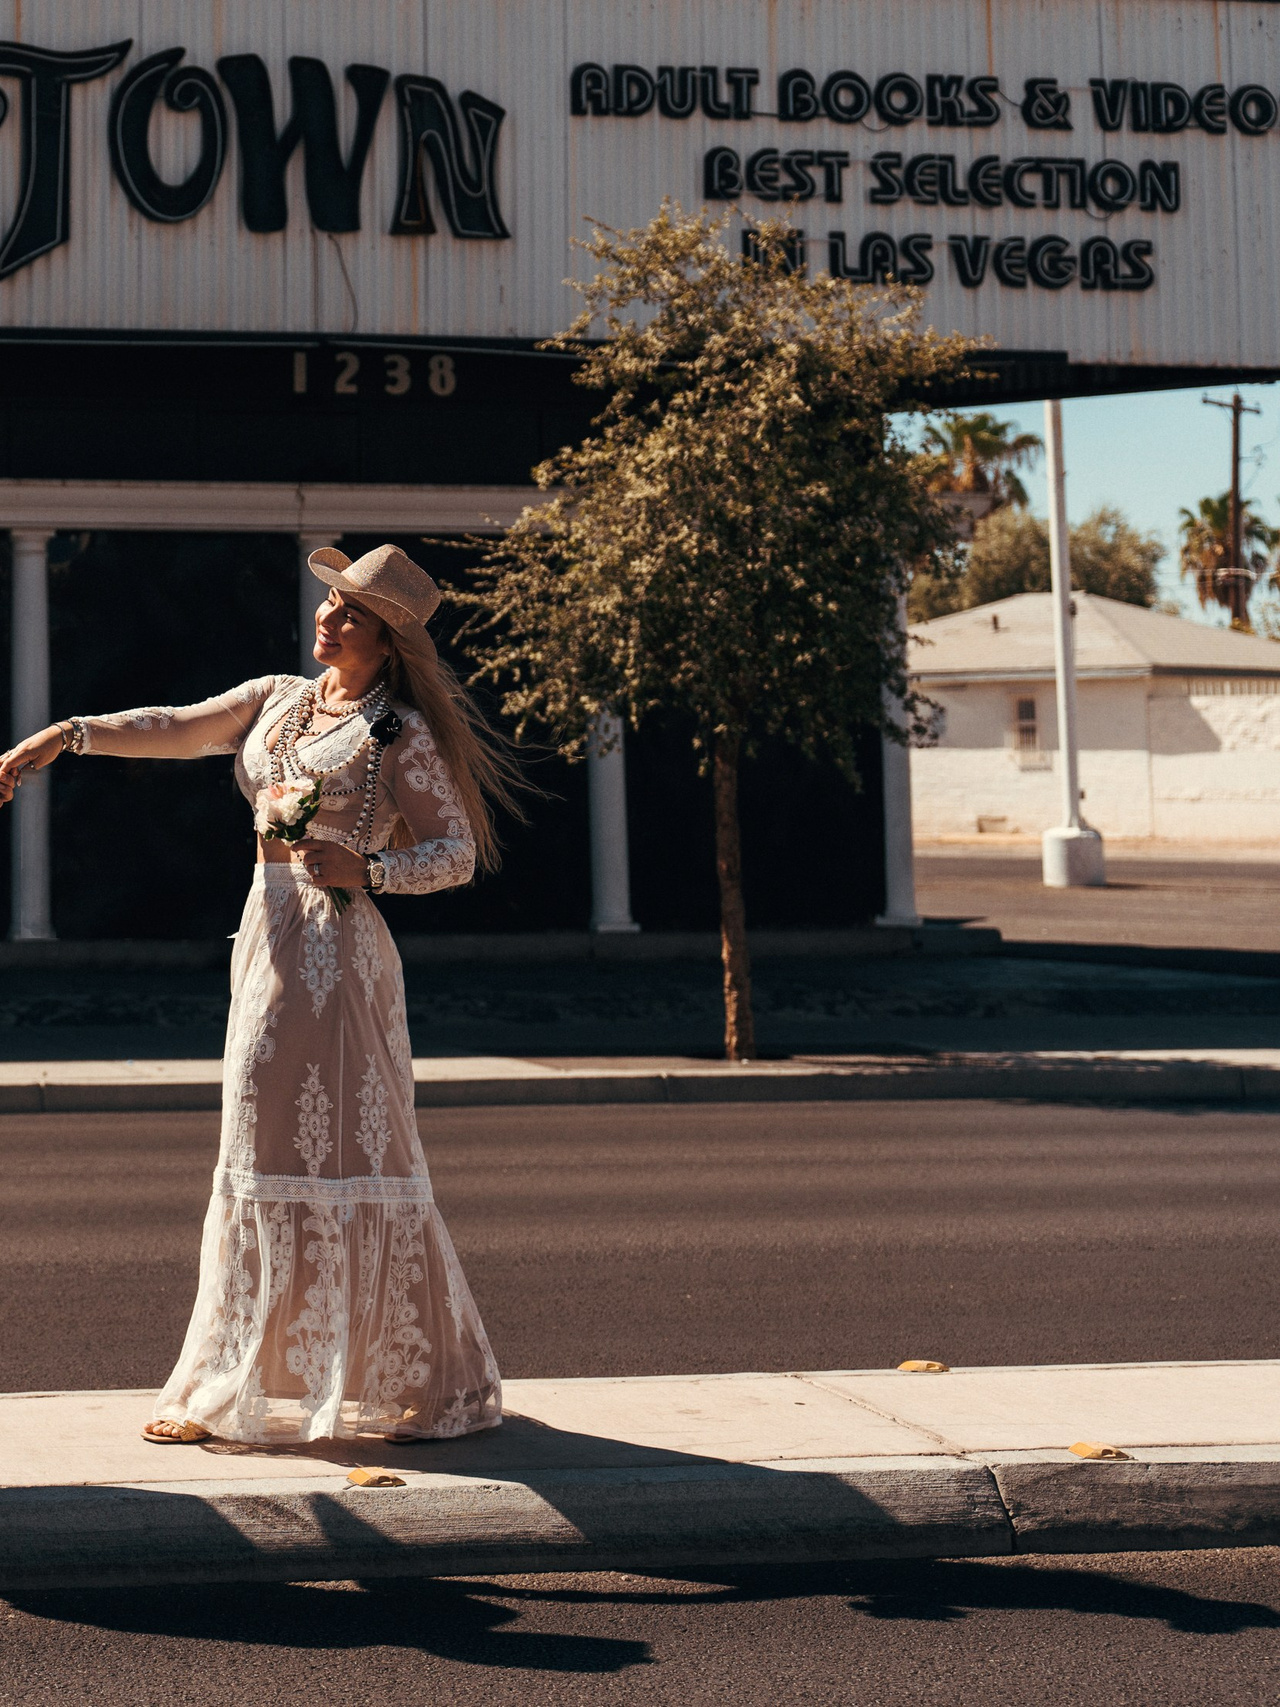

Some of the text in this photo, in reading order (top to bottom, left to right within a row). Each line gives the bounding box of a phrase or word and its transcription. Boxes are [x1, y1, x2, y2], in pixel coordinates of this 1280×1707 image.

[570, 62, 1279, 136] ADULT BOOKS & VIDEO
[703, 146, 1181, 213] BEST SELECTION
[829, 230, 934, 287] LAS
[949, 234, 1156, 292] VEGAS
[293, 351, 458, 395] 1238
